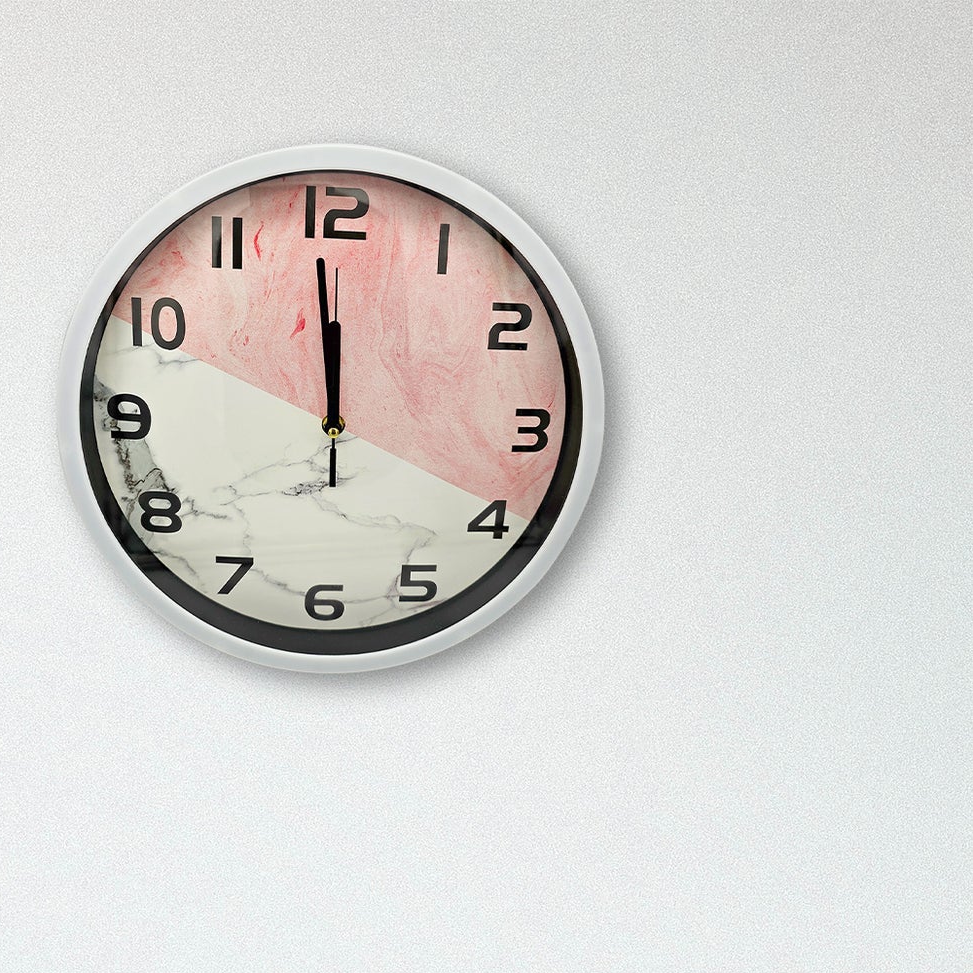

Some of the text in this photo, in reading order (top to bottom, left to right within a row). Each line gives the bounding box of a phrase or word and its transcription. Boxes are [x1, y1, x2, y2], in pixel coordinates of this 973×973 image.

[304, 185, 370, 240] 12
[211, 216, 243, 269] 11
[436, 223, 450, 275] 1
[131, 297, 186, 350] 10
[487, 302, 532, 350] 2
[106, 394, 152, 440] 9
[512, 408, 551, 452] 3
[139, 490, 182, 533] 8
[466, 499, 510, 539] 4
[215, 556, 254, 595] 7
[398, 565, 438, 602] 5
[303, 584, 345, 621] 6
